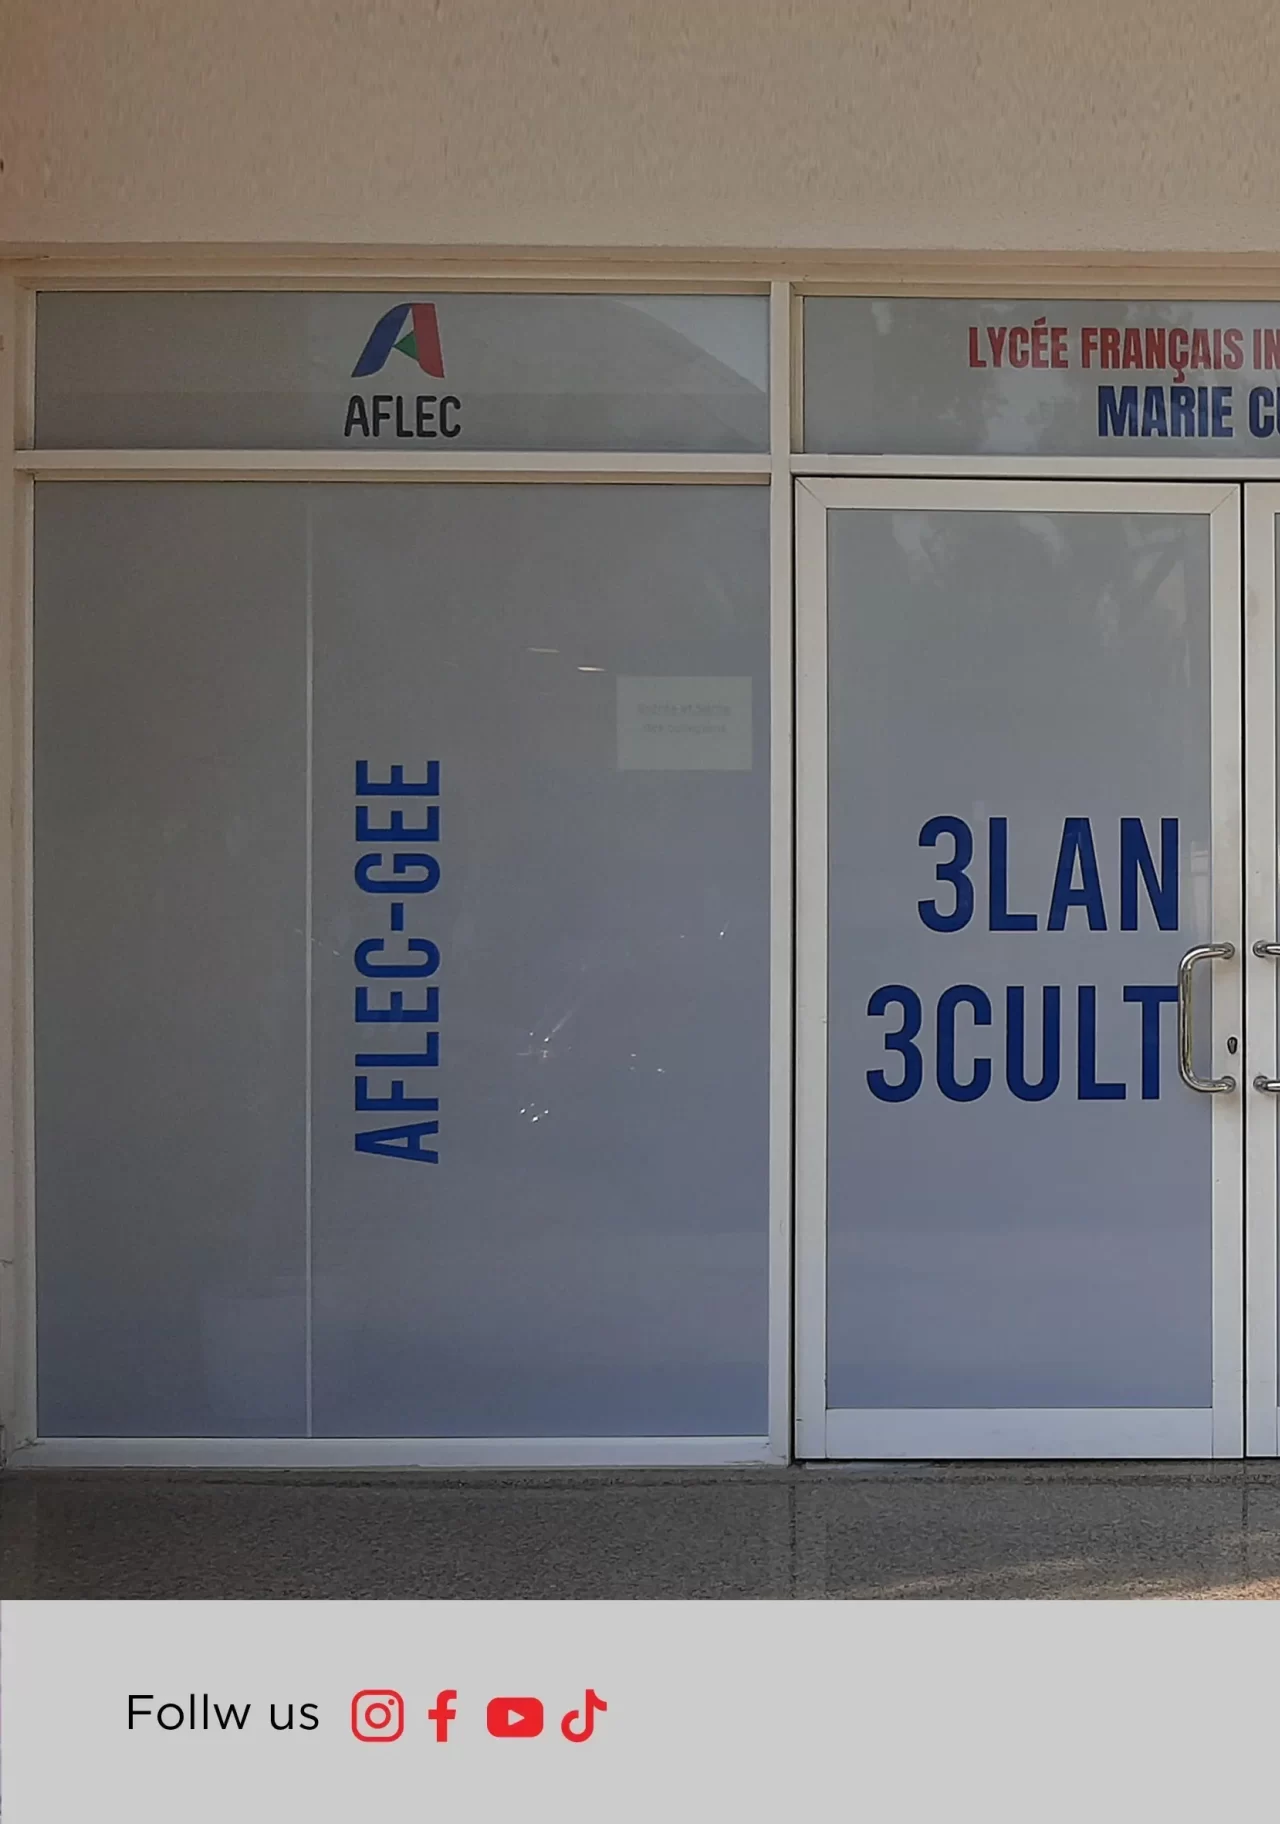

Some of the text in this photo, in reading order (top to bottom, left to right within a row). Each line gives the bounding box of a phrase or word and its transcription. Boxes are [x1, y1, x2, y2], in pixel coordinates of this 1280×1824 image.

[969, 317, 1068, 368] LYCÉE
[1081, 327, 1244, 384] FRANÇAIS
[344, 395, 461, 438] AFLEC
[1098, 386, 1233, 437] MARIE
[918, 816, 1179, 932] 3LAN
[355, 760, 441, 1164] AFLEC-GEE
[866, 984, 1179, 1102] 3CULT
